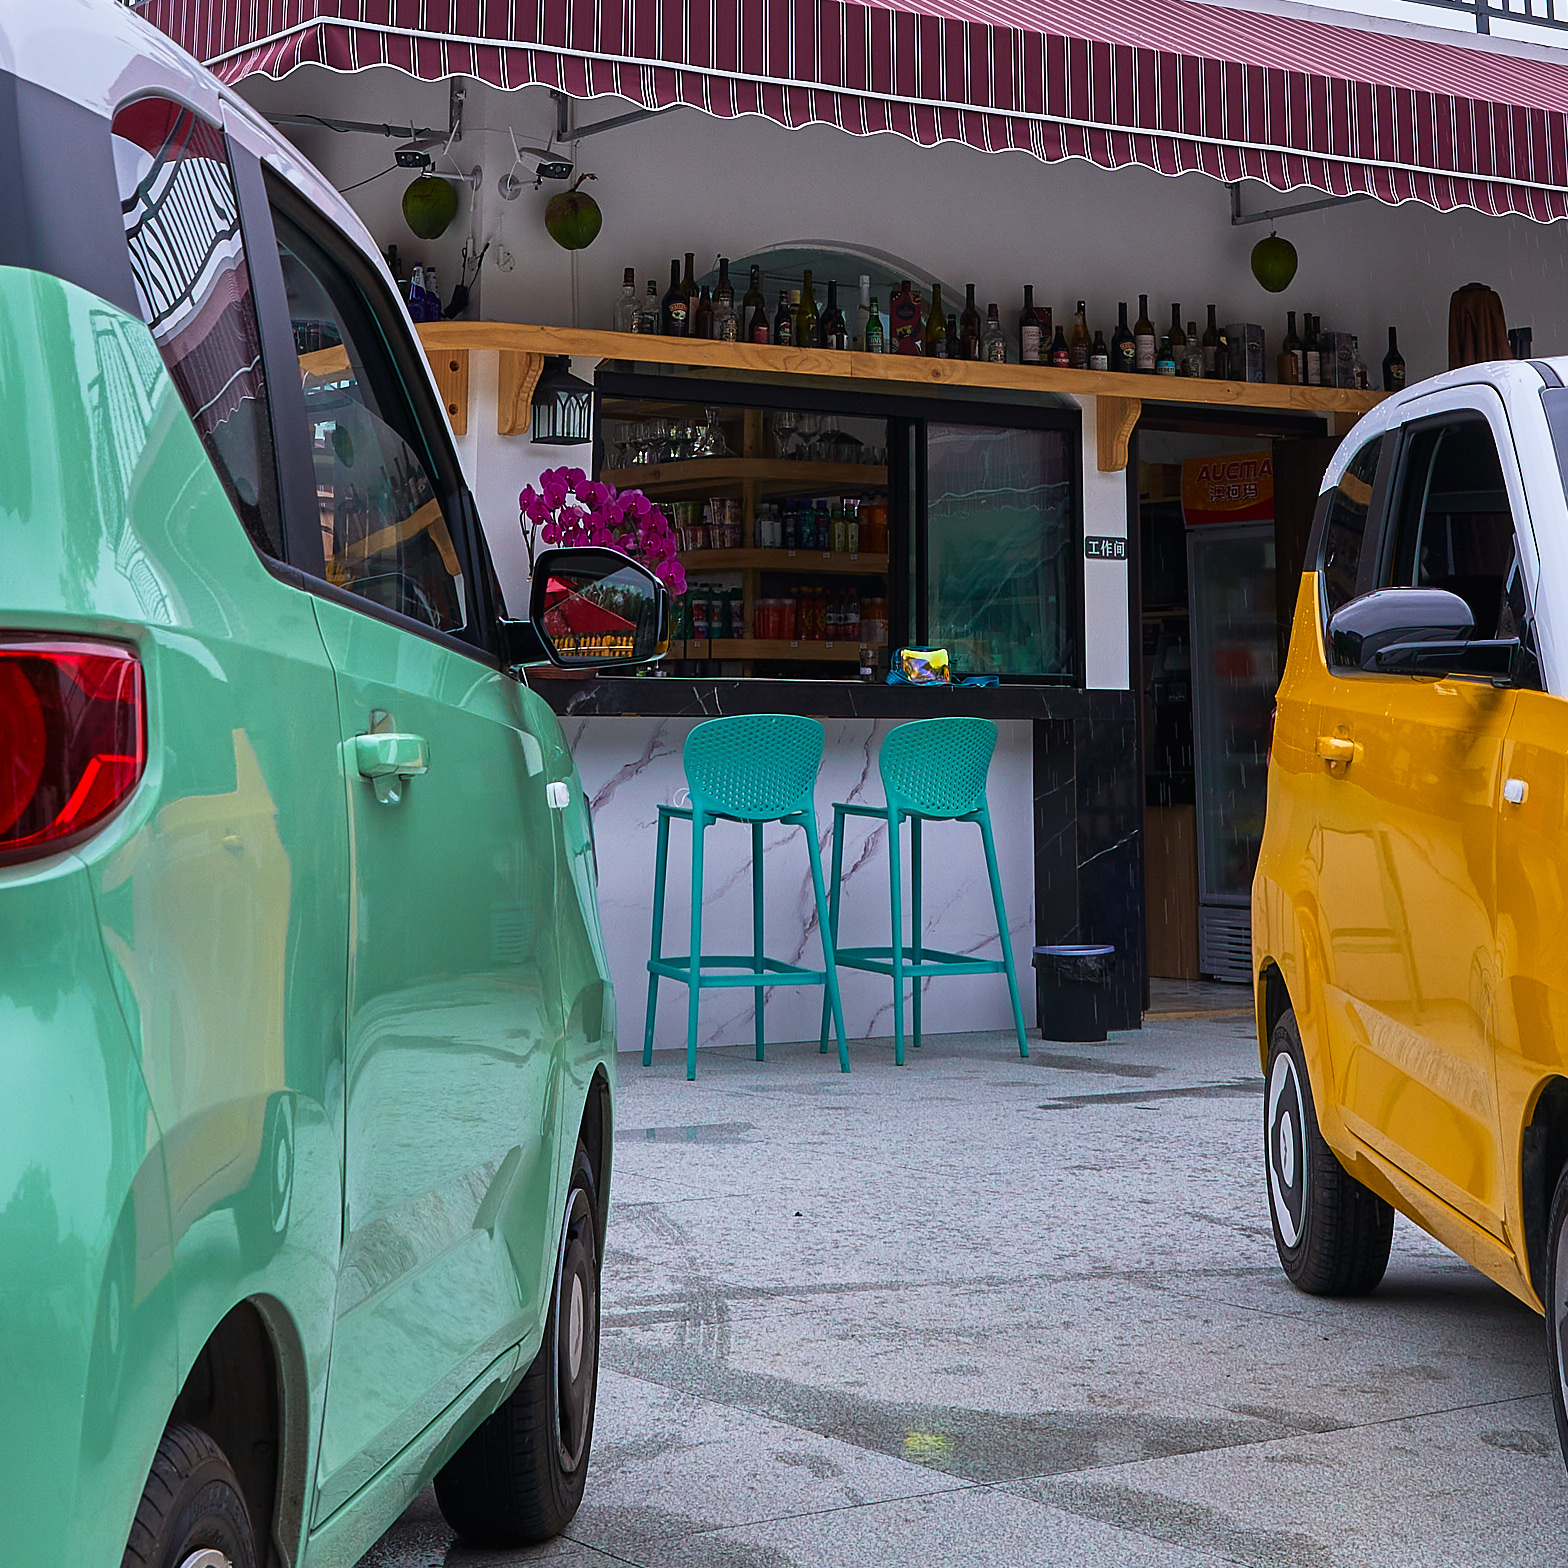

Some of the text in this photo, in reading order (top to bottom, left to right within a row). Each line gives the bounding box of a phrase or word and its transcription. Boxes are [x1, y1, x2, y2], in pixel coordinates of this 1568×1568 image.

[1195, 458, 1273, 483] AUCMA
[1209, 482, 1259, 502] 澳柯玛
[1088, 540, 1125, 557] 工作间
